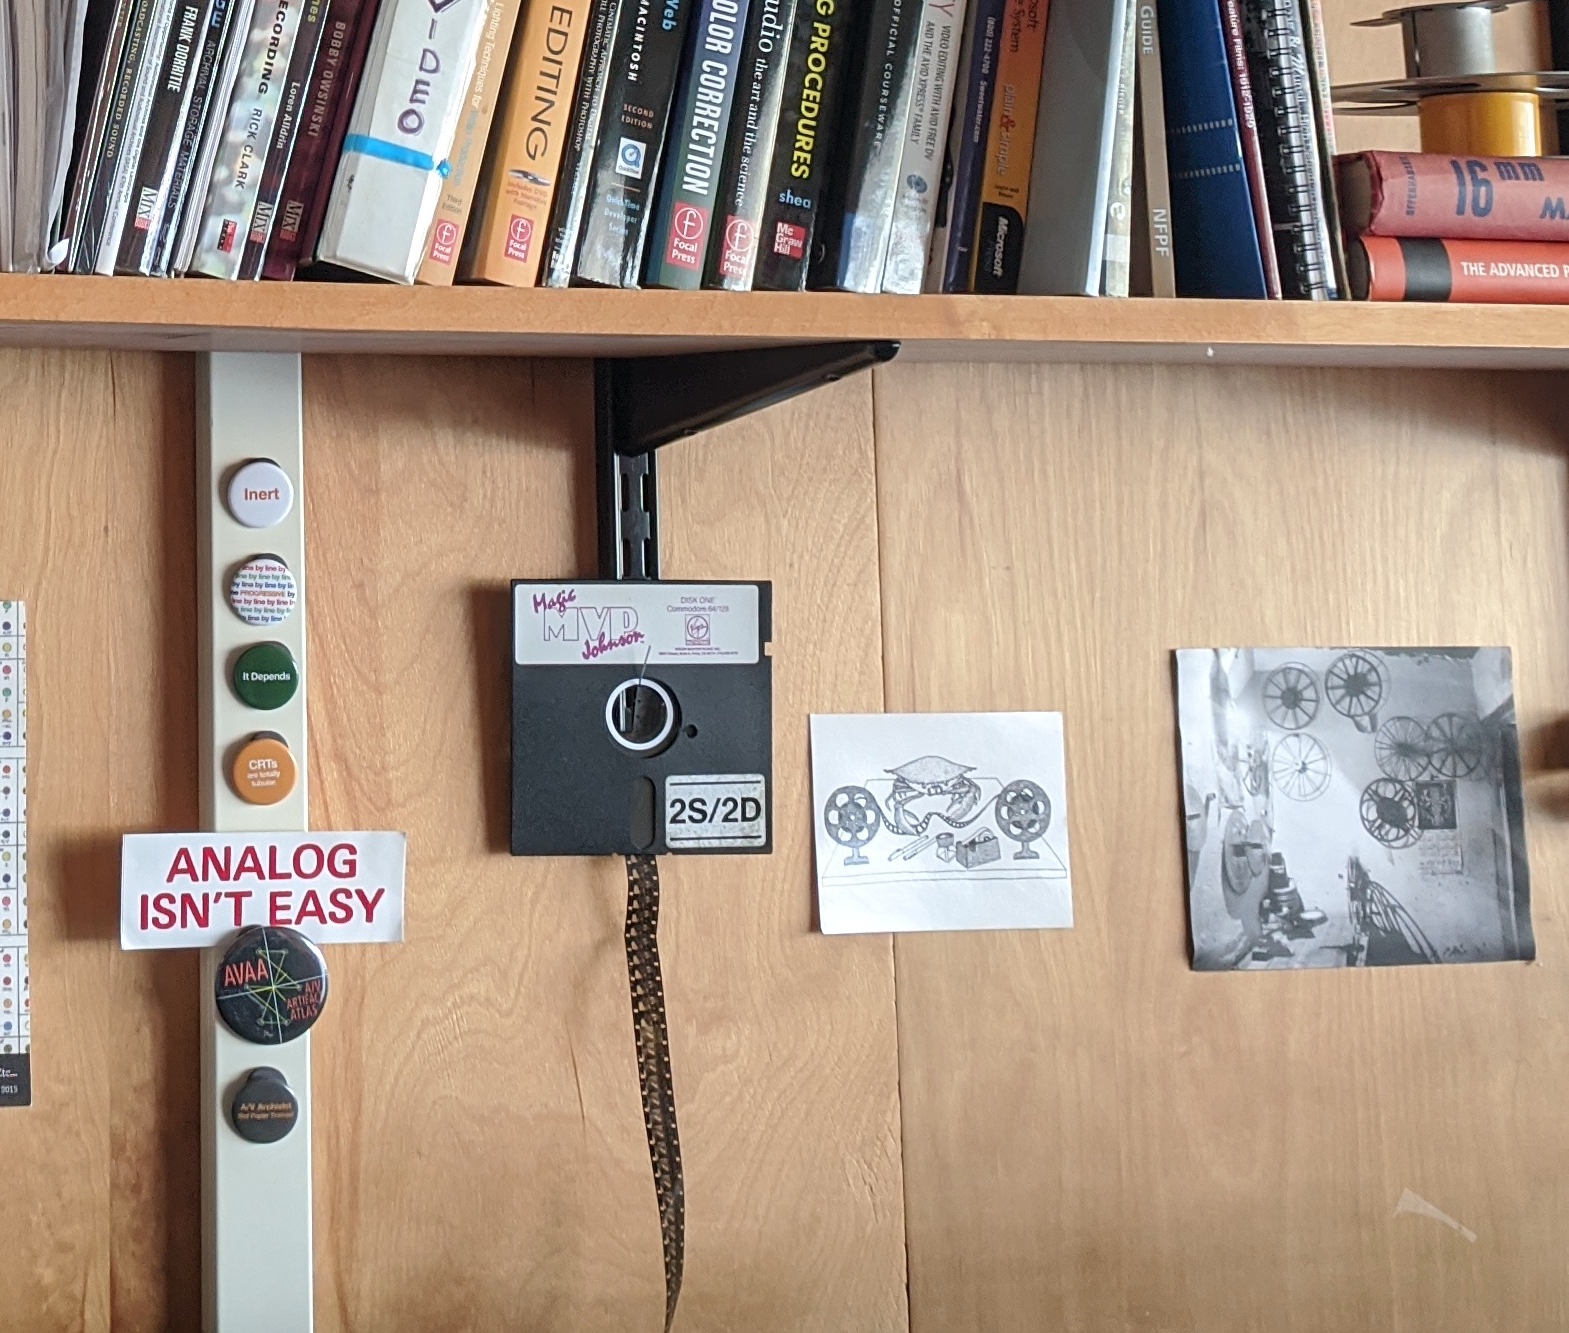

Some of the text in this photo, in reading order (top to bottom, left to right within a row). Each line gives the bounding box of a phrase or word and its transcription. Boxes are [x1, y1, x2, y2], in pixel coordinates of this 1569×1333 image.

[628, 0, 649, 81] MACINTOSH
[924, 21, 935, 39] AND
[1010, 8, 1025, 53] System
[1140, 5, 1154, 54] GUIDE
[167, 6, 198, 92] FRANK DORRITIE
[471, 2, 504, 108] Lighting Techniques for
[922, 40, 933, 56] THE
[308, 21, 346, 137] BOBBY OWSINSKI
[873, 0, 902, 147] OFFICIAL COURSEWARE
[919, 56, 931, 77] AVID
[115, 68, 133, 120] RECORDED
[235, 0, 289, 189] ECORDING RICK CLARK
[525, 5, 573, 162] EDITING
[683, 0, 738, 194] OLOR CORRECTION
[791, 0, 834, 177] G PROCEDURES
[924, 25, 951, 161] VIDEO EDITING WITH AVID FREE DV
[276, 81, 301, 149] Loren Alldrin
[623, 103, 655, 118] SECOND
[735, 0, 783, 207] udio the art and the science
[165, 40, 216, 209] ARCHIVAL STORAGE MATERIALS
[621, 114, 653, 129] EDITION
[910, 113, 923, 144] FAMILY
[106, 124, 120, 158] SOUND
[779, 189, 812, 209] shea
[1450, 159, 1545, 218] 16 mm
[1539, 196, 1569, 220] M
[775, 233, 803, 248] Graw
[777, 222, 793, 236] Mc
[1152, 208, 1170, 256] NFPF
[432, 250, 450, 262] Press
[435, 242, 452, 254] Focal
[507, 247, 525, 259] Press
[509, 239, 528, 251] Focal
[671, 249, 696, 264] Press
[673, 237, 699, 253] Focal
[725, 250, 750, 266] Focal
[774, 242, 791, 256] Hill
[993, 216, 1008, 276] Microsoft
[1460, 261, 1560, 278] THE ADVANCED
[244, 487, 280, 501] Inert
[532, 588, 577, 614] Magic
[680, 596, 715, 604] DISK ONE
[708, 605, 730, 613] 64/128
[543, 606, 639, 641] MVP
[582, 631, 645, 661] Johnson
[242, 671, 291, 683] It Depends
[248, 758, 278, 770] CRTs
[668, 796, 762, 825] 2S/2D
[166, 843, 359, 883] ANALOG
[140, 888, 385, 931] ISN'T EASY
[224, 958, 269, 988] AVAA
[304, 980, 321, 993] A/V
[291, 1003, 318, 1021] ATLAS
